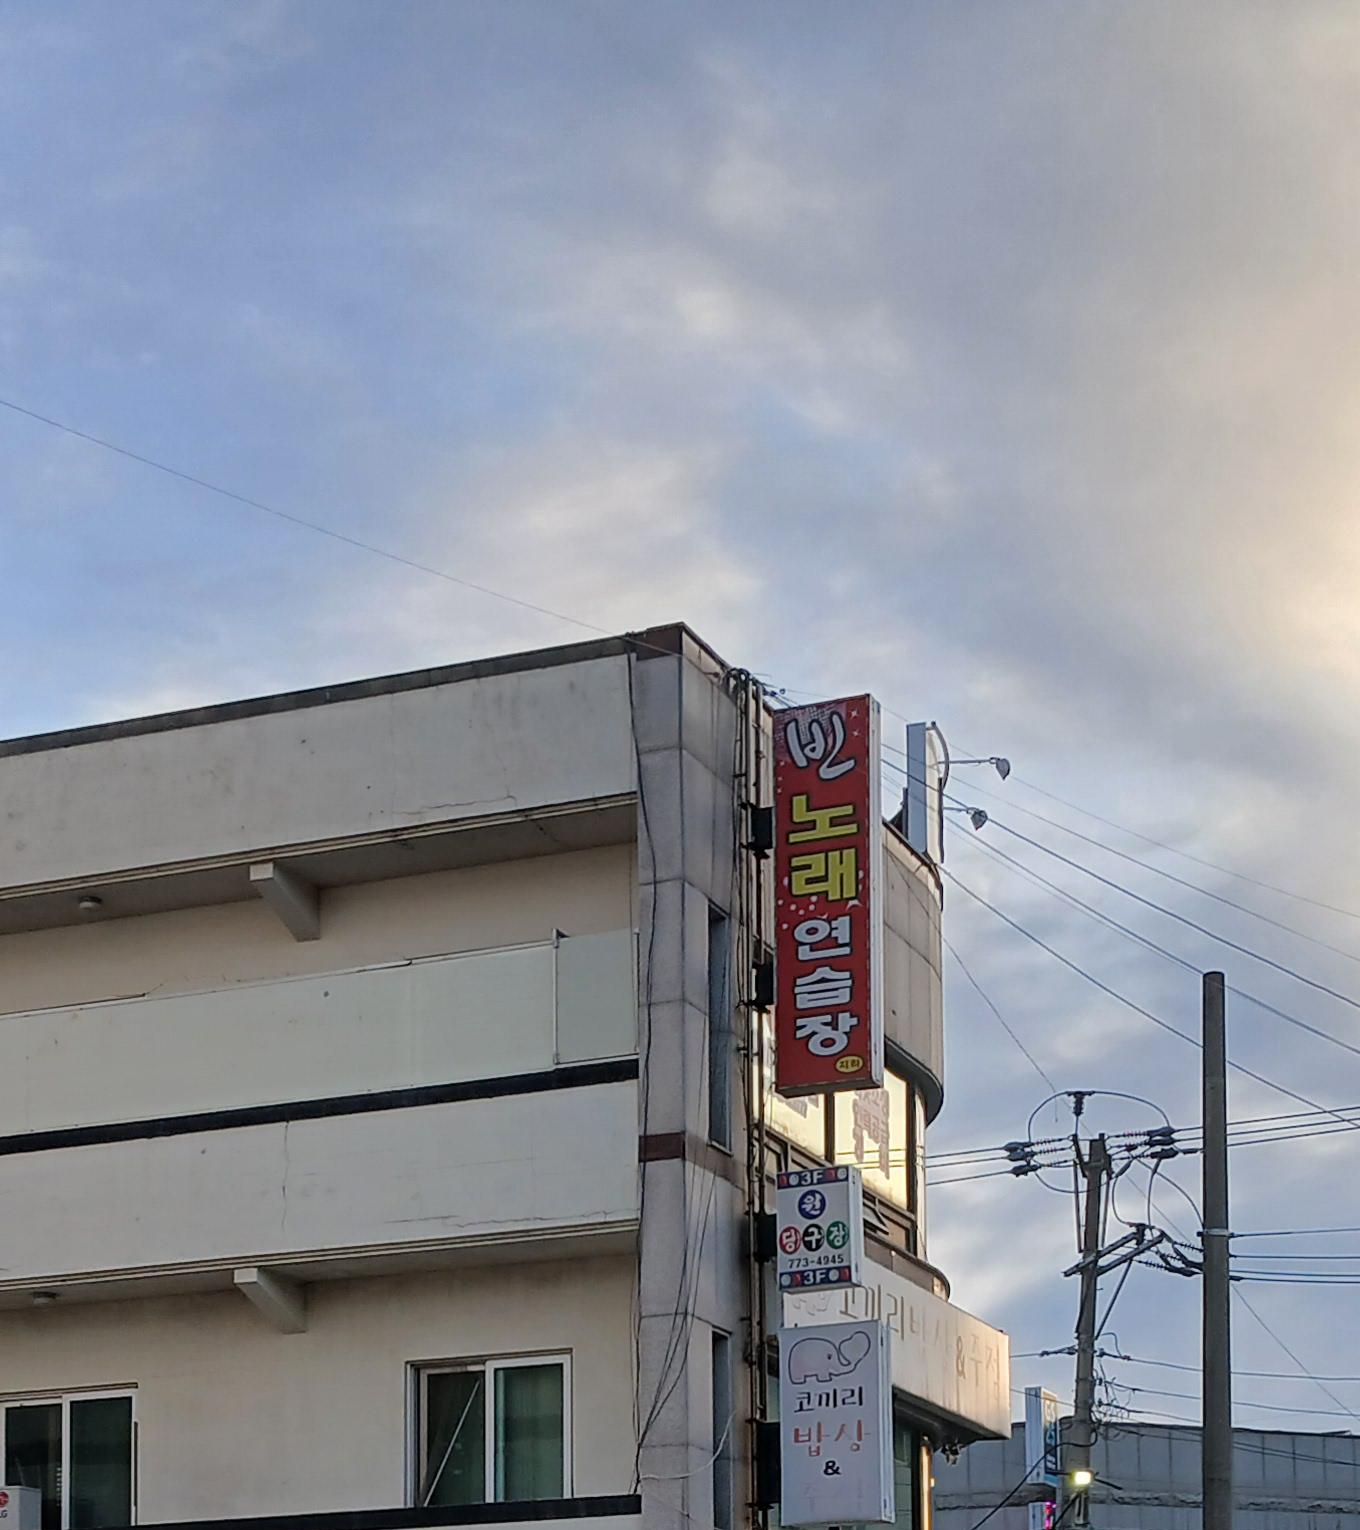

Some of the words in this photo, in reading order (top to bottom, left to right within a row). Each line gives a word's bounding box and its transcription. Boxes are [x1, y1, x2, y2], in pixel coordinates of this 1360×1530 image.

[788, 794, 860, 1057] 노래연습장
[801, 1170, 824, 1185] 3F
[781, 1222, 847, 1252] 당구장
[787, 1255, 844, 1269] 773-4945
[803, 1269, 827, 1285] 3F
[793, 1385, 864, 1413] 코끼리
[793, 1419, 872, 1457] 밥상
[823, 1459, 842, 1476] &
